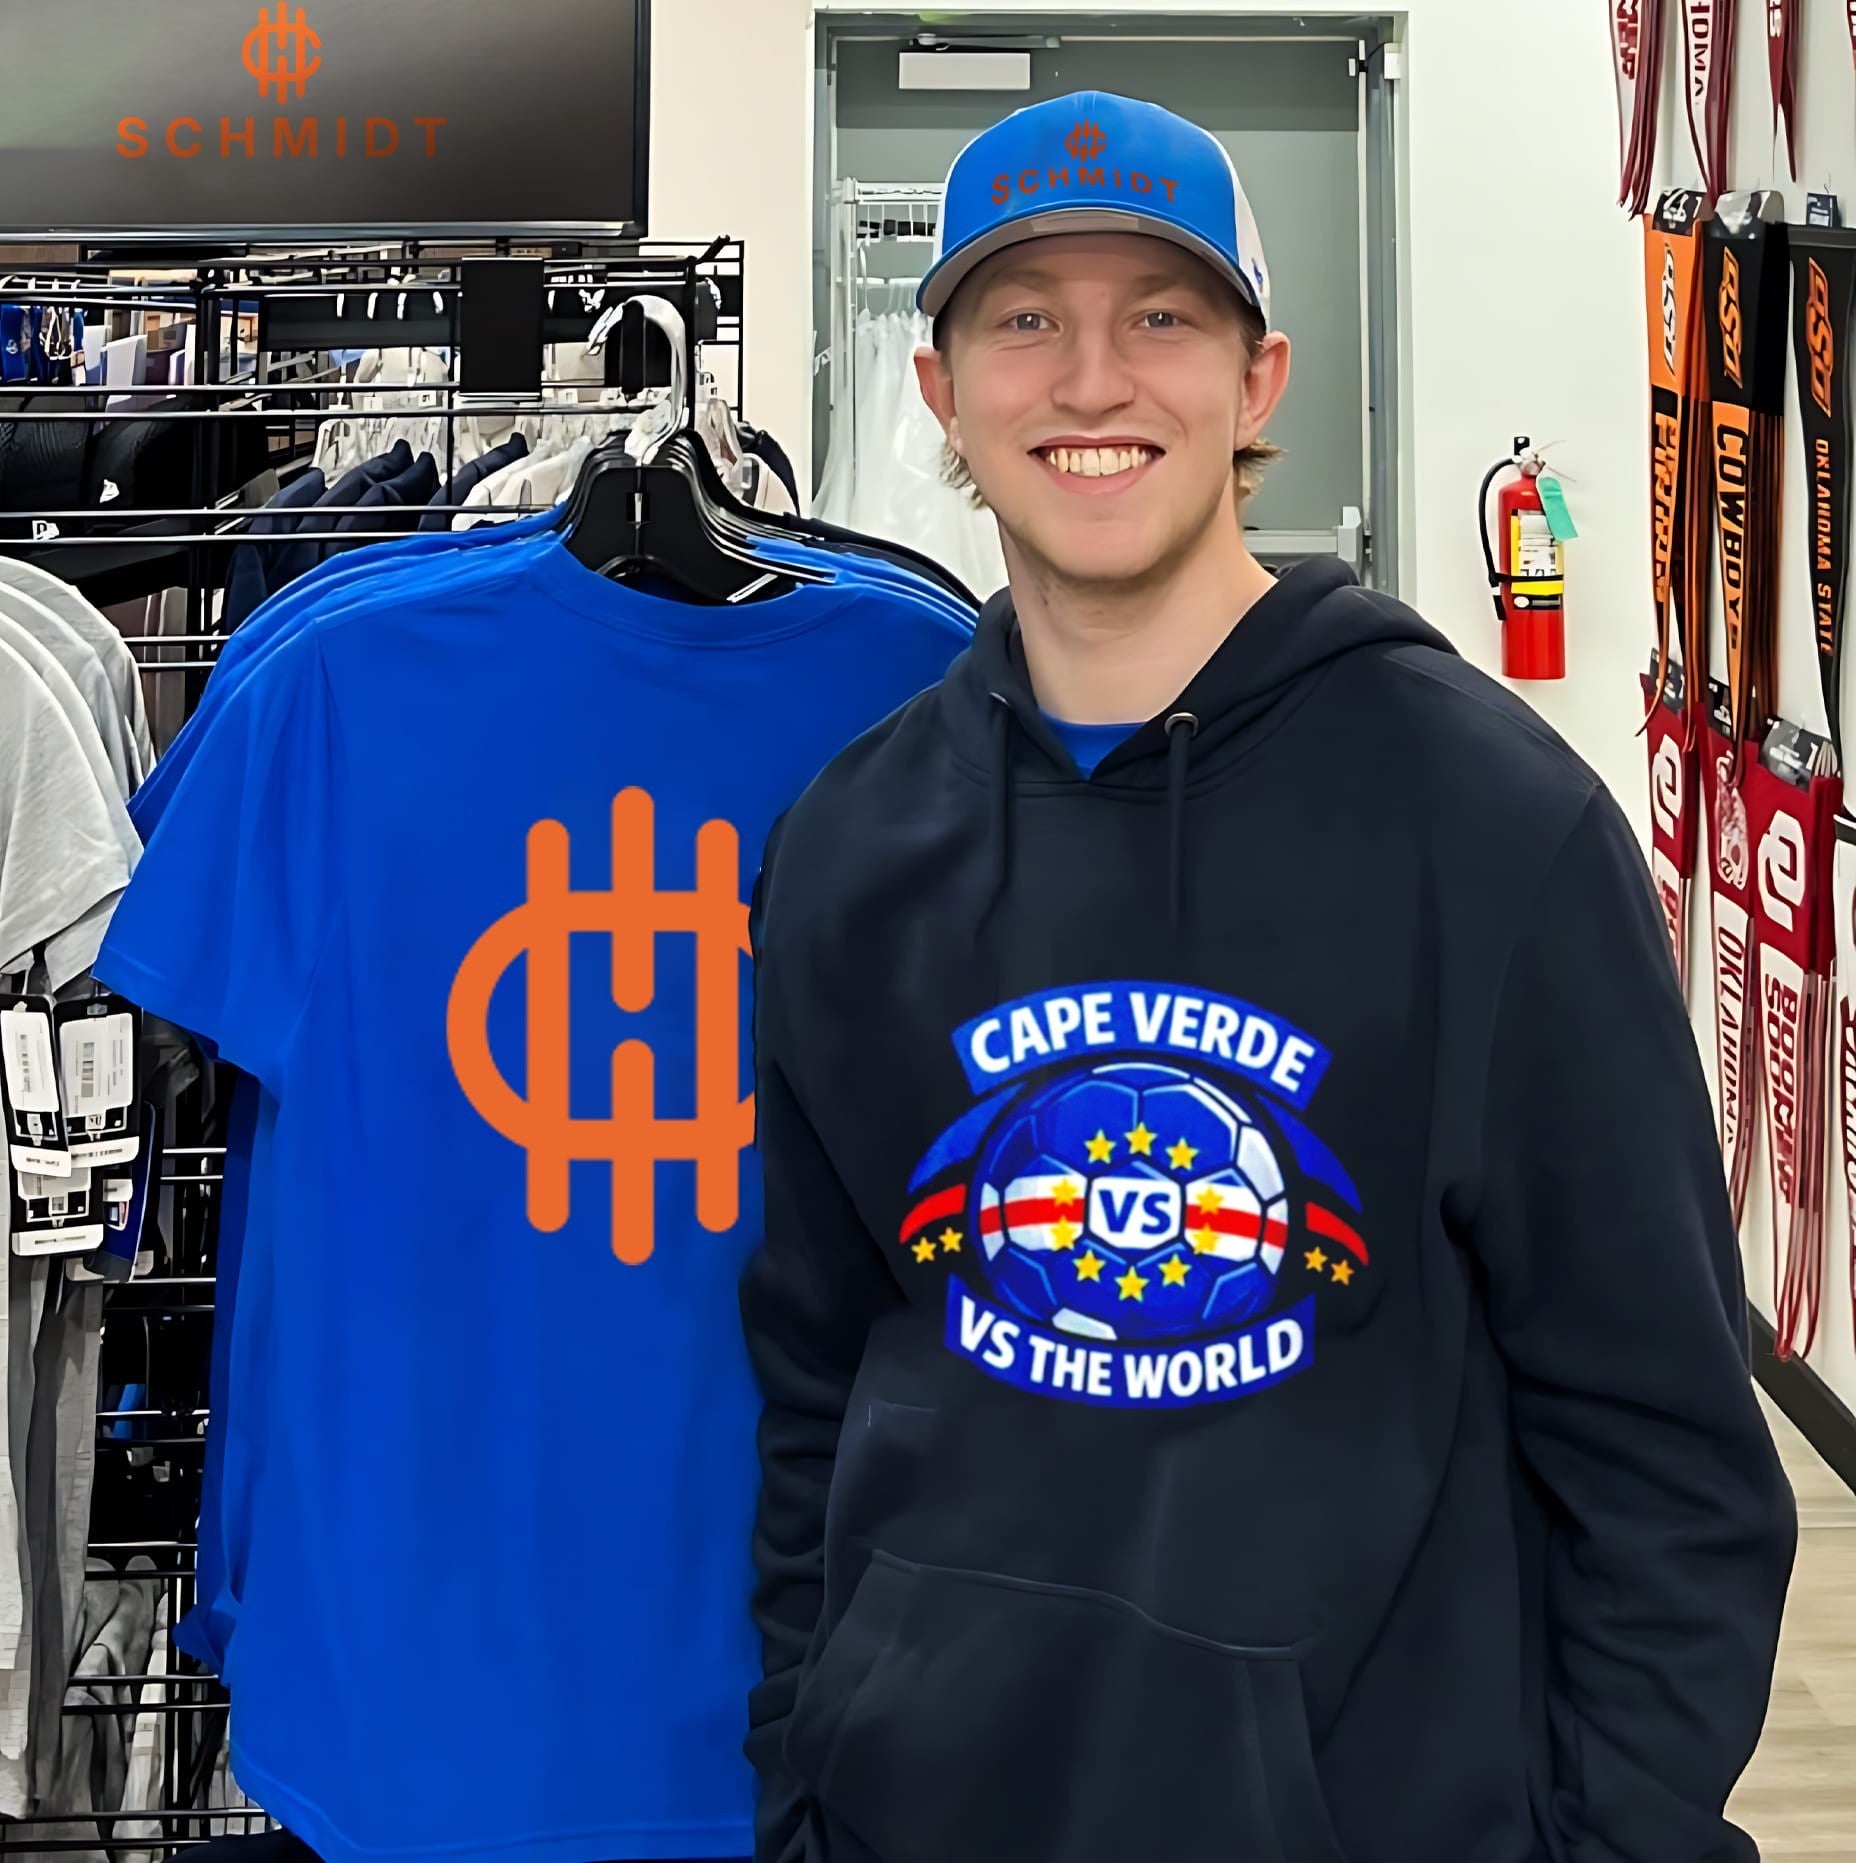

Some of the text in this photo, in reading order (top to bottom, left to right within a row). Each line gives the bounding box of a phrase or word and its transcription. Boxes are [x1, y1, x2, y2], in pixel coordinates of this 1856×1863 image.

[116, 117, 447, 158] SCHMIDT
[991, 167, 1179, 204] SCHMIDT
[1815, 438, 1832, 570] OKLAHOMA
[970, 991, 1316, 1093] CAPE VERDE
[1717, 925, 1745, 1145] OKLAHOMA
[1098, 1189, 1173, 1235] VS
[959, 1295, 1304, 1399] VS THE WORLD
